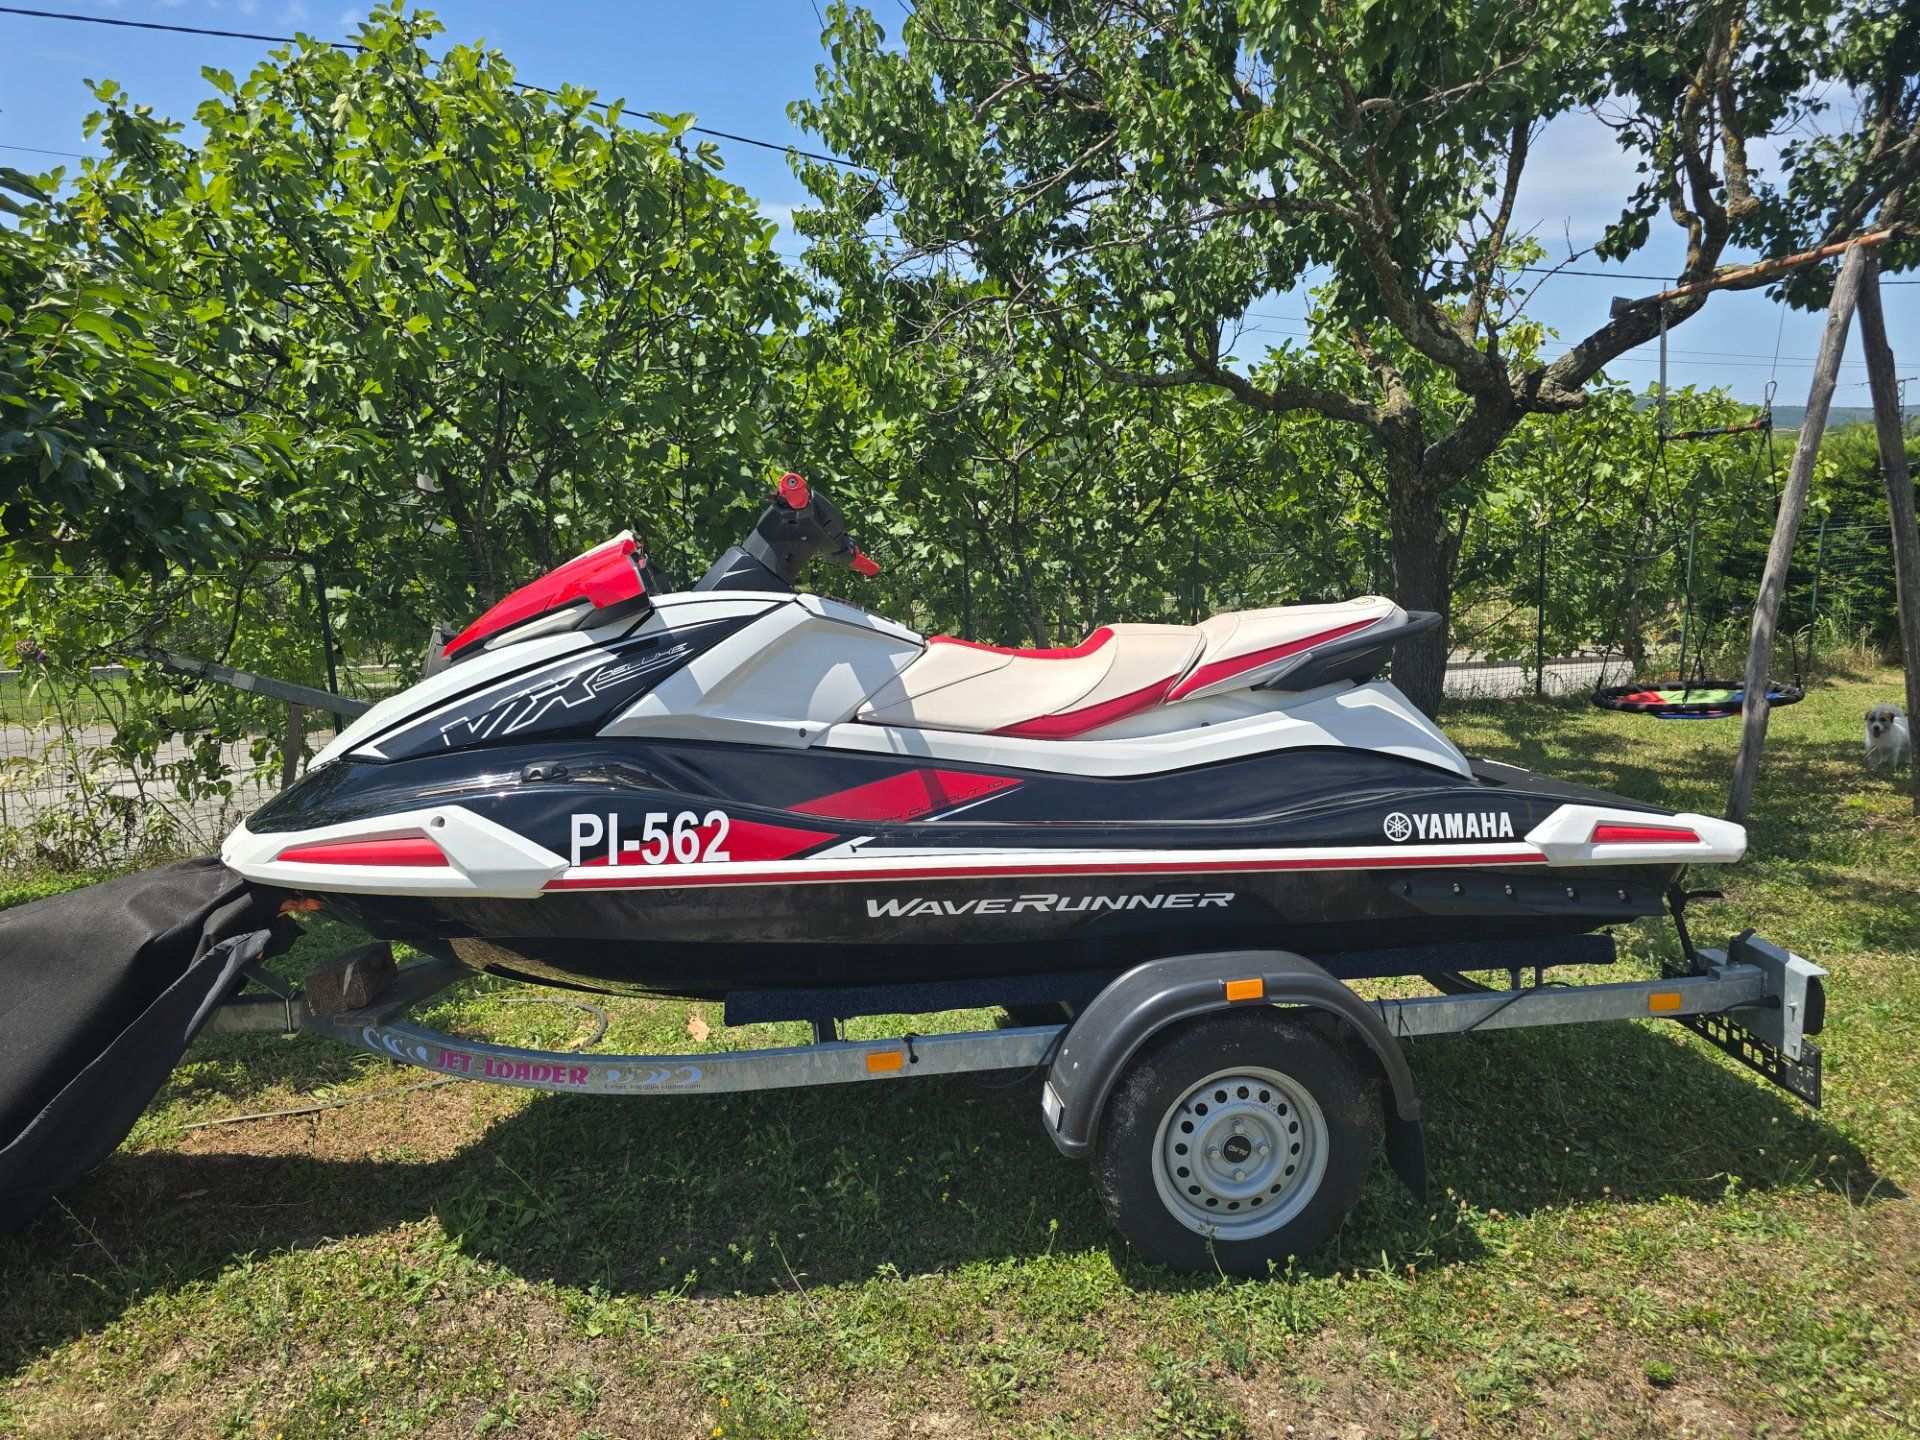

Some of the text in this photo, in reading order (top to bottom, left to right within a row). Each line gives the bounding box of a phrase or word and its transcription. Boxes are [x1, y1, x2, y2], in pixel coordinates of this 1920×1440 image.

[597, 642, 688, 681] DELUXE
[440, 665, 607, 746] VX
[571, 810, 730, 867] PI-562
[1412, 811, 1515, 840] YAMAHA
